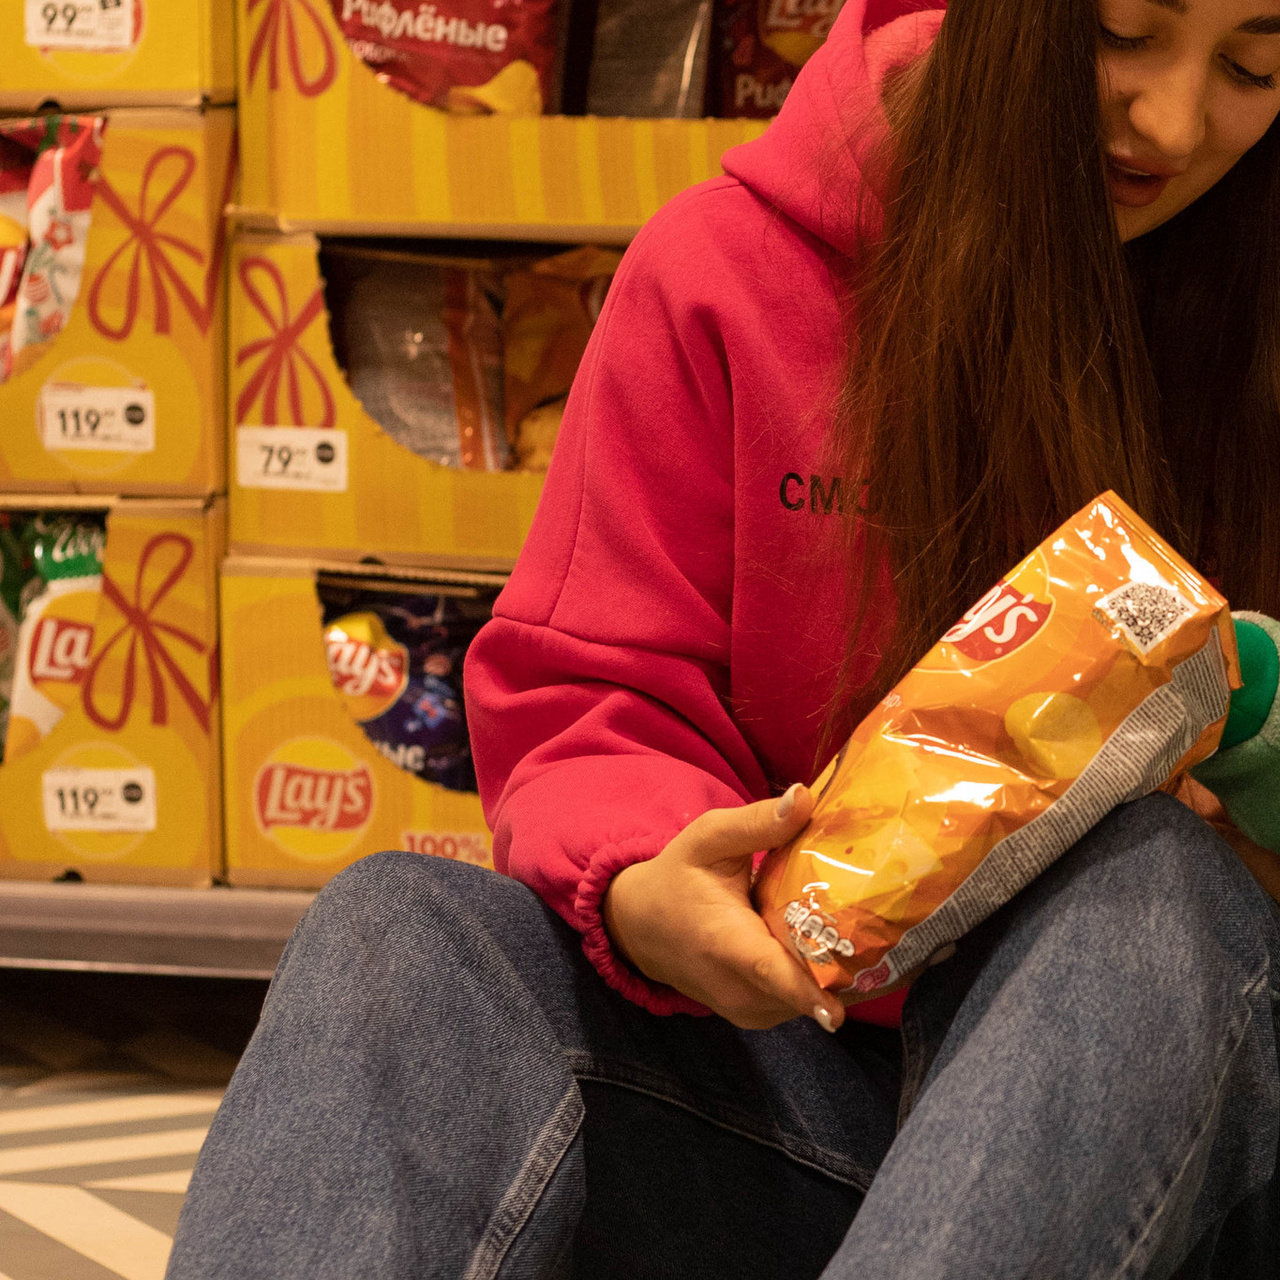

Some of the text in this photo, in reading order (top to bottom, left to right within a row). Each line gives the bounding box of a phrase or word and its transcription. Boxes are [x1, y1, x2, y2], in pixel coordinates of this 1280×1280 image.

[41, 2, 77, 30] 99
[57, 408, 100, 435] 119
[260, 445, 293, 471] 79
[57, 787, 99, 812] 119
[406, 833, 489, 863] 100%
